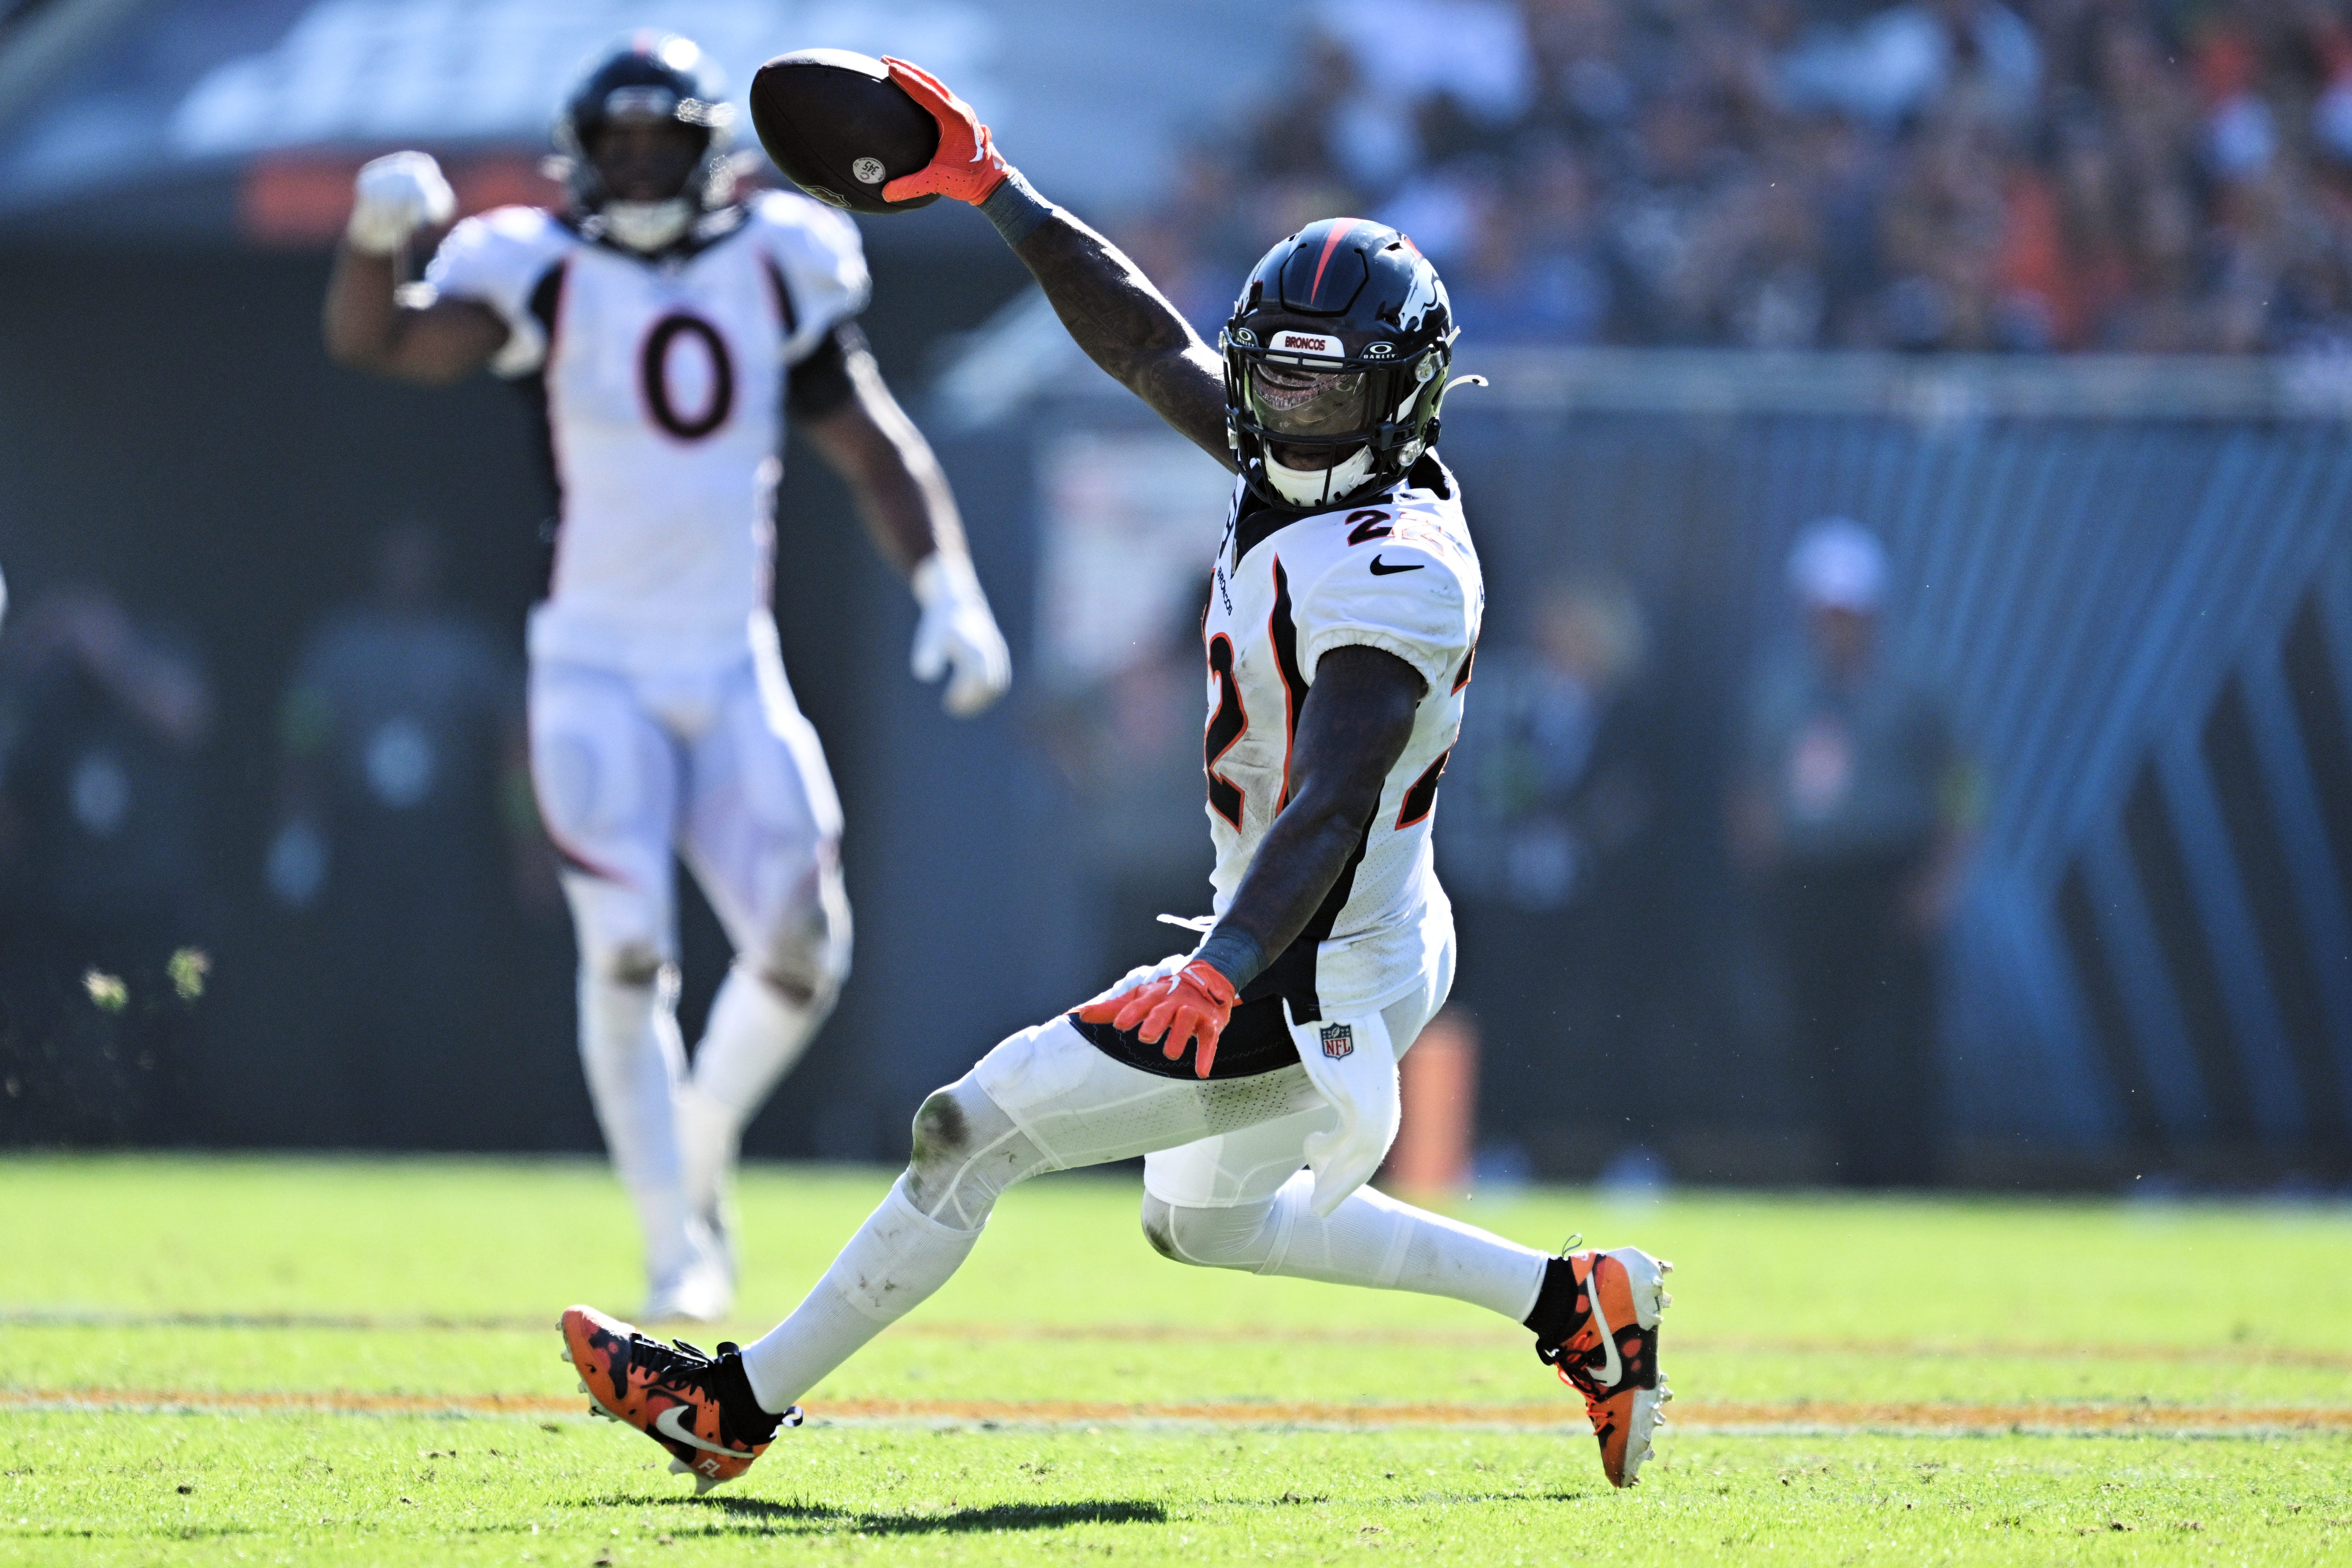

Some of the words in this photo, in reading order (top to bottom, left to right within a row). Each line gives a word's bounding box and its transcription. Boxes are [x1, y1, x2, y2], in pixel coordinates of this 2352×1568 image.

[862, 161, 879, 175] 345
[1285, 336, 1326, 351] BRONCOS
[638, 308, 736, 444] 0
[1345, 510, 1444, 557] 22
[1217, 566, 1233, 616] BRONCOS
[1325, 1038, 1350, 1056] NFL
